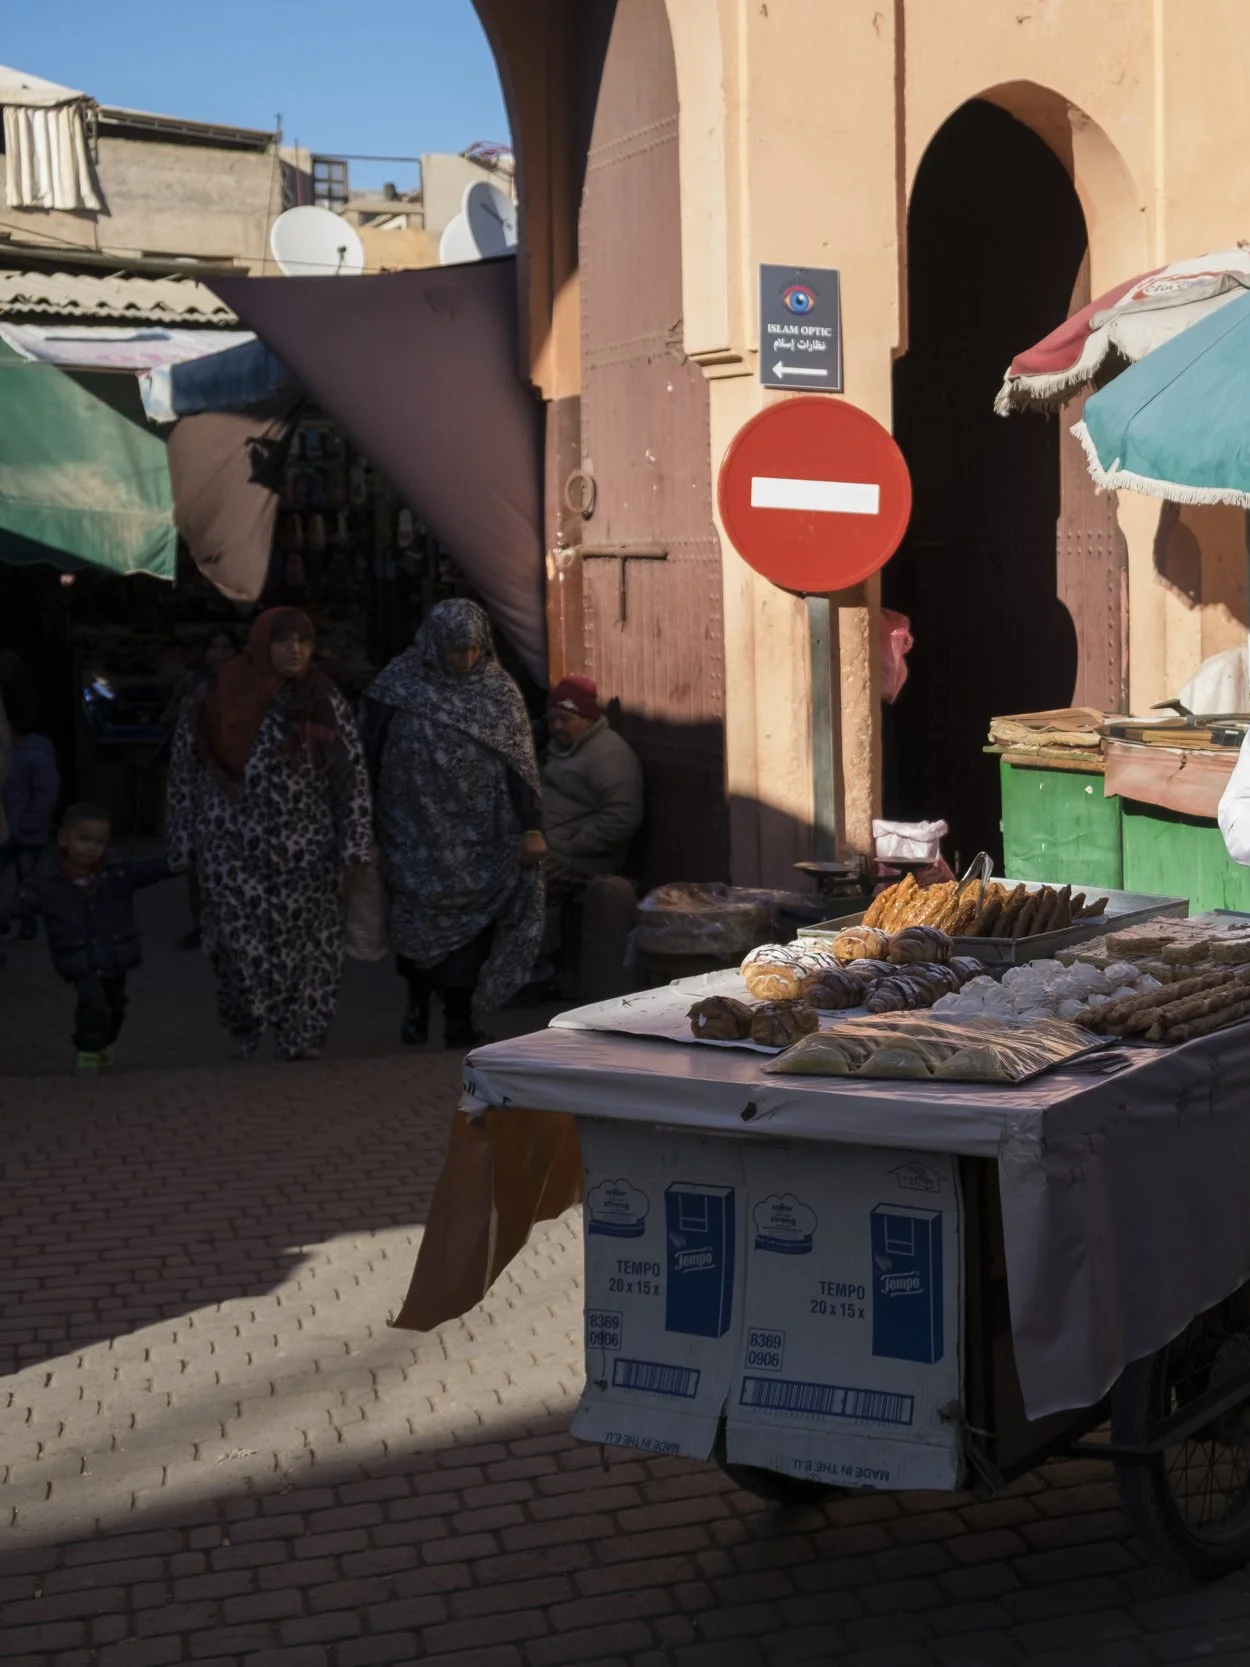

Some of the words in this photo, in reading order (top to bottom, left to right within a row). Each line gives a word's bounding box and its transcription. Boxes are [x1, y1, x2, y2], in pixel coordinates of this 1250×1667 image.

[767, 323, 799, 335] ISLAM
[800, 325, 832, 337] OPTIC
[797, 339, 826, 352] نظارات
[604, 1201, 630, 1210] strong
[770, 1215, 797, 1226] strong
[674, 1247, 714, 1272] Tempo
[616, 1260, 661, 1277] TEMPO
[609, 1278, 624, 1292] 20
[627, 1282, 633, 1293] x
[637, 1281, 651, 1295] 15
[653, 1284, 660, 1295] x
[819, 1281, 865, 1300] TEMPO
[880, 1272, 922, 1296] Tempo
[810, 1300, 826, 1315] 20
[830, 1305, 836, 1316] x
[840, 1303, 855, 1318] 15
[858, 1307, 865, 1319] x
[590, 1314, 619, 1329] 8369
[590, 1331, 619, 1347] 0906
[749, 1332, 781, 1349] 8369
[748, 1351, 780, 1367] 0906
[624, 1434, 640, 1447] THE
[641, 1438, 652, 1448] IN
[655, 1440, 680, 1454] MADE
[815, 1461, 838, 1475] THE
[841, 1465, 853, 1476] IN
[855, 1467, 890, 1481] MADE
